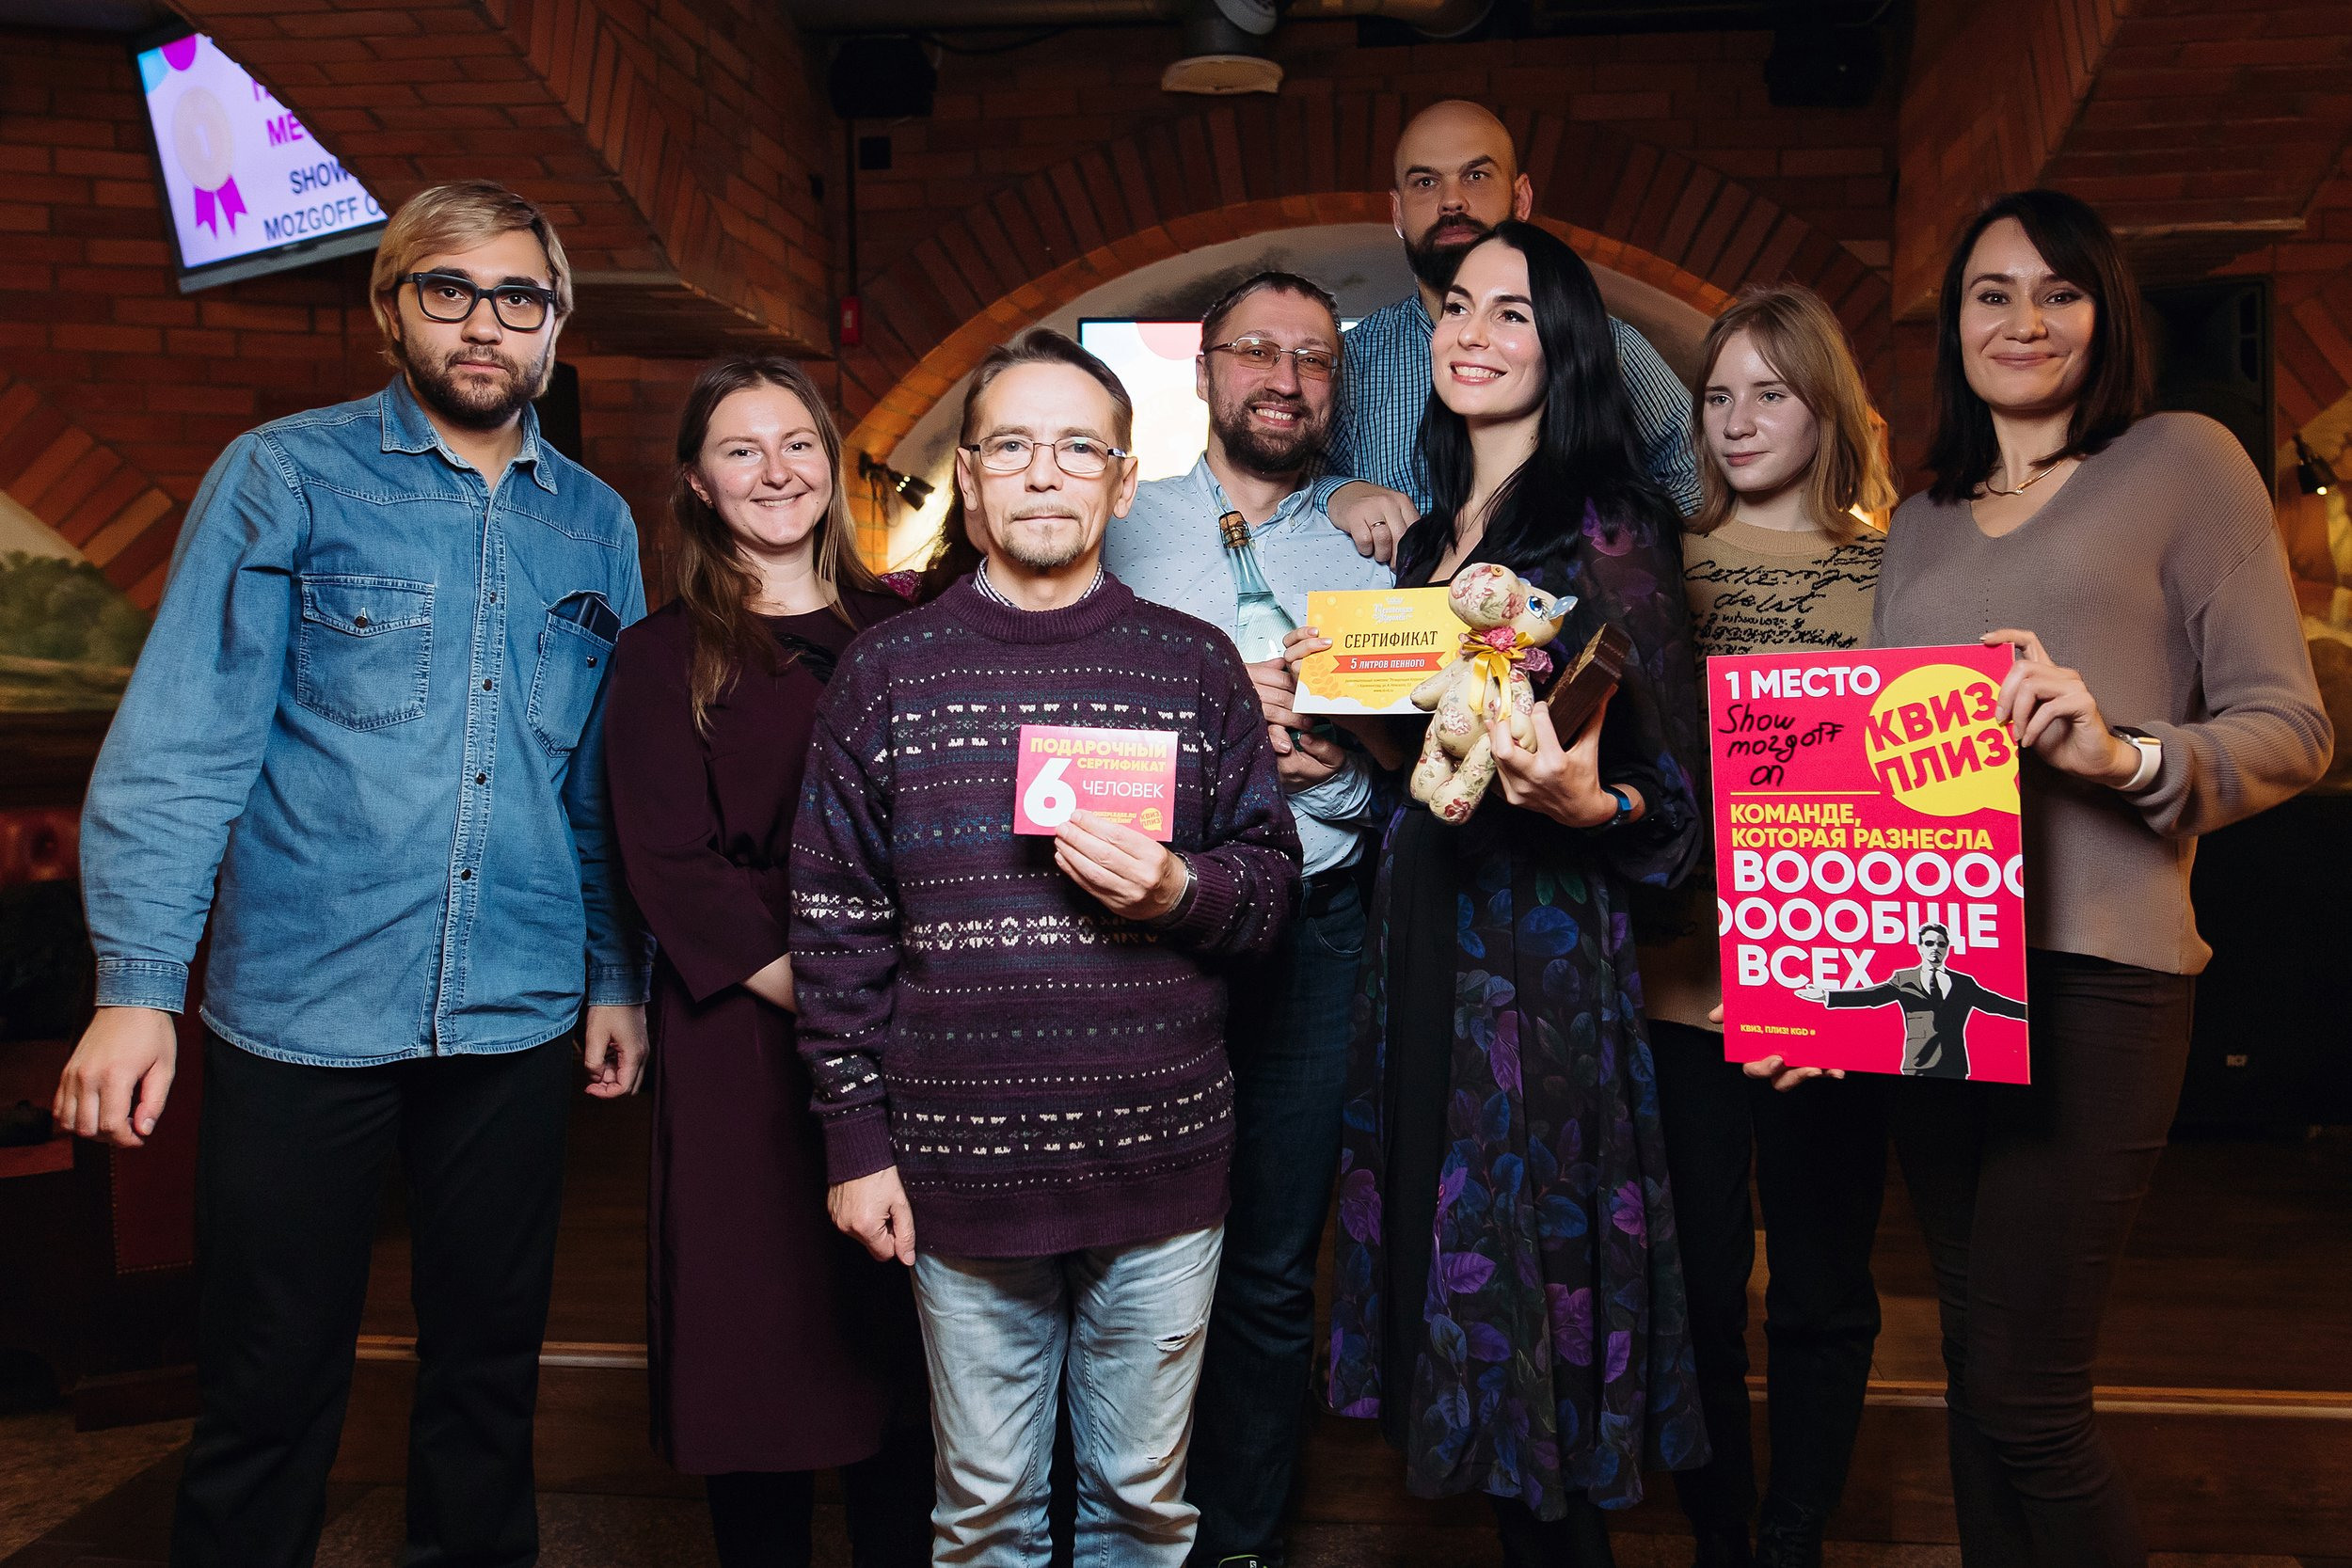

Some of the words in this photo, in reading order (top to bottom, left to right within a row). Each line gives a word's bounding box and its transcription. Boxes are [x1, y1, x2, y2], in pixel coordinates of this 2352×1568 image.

[263, 197, 358, 241] MOZGOFF
[1344, 631, 1438, 649] СЕРТИФИКАТ
[1350, 657, 1358, 670] 5
[1359, 659, 1389, 670] ЛИТРОВ
[1390, 658, 1425, 669] ПЕННОГО
[1725, 671, 1740, 700] 1
[1751, 664, 1881, 699] МЕСТО
[1717, 703, 1796, 735] Show
[1868, 681, 1997, 753] КВИЗ
[1030, 736, 1168, 759] ПОДАРОЧНЫЙ
[1076, 757, 1167, 773] СЕРТИФИКАТ
[1023, 757, 1077, 828] 6
[1082, 779, 1165, 799] ЧЕЛОВЕК
[1730, 803, 1862, 828] КОМАНДЕ,
[1731, 828, 1847, 848] КОТОРАЯ
[1853, 829, 1994, 850] РАЗНЕСЛА
[1737, 943, 1876, 990] ВСЕХ
